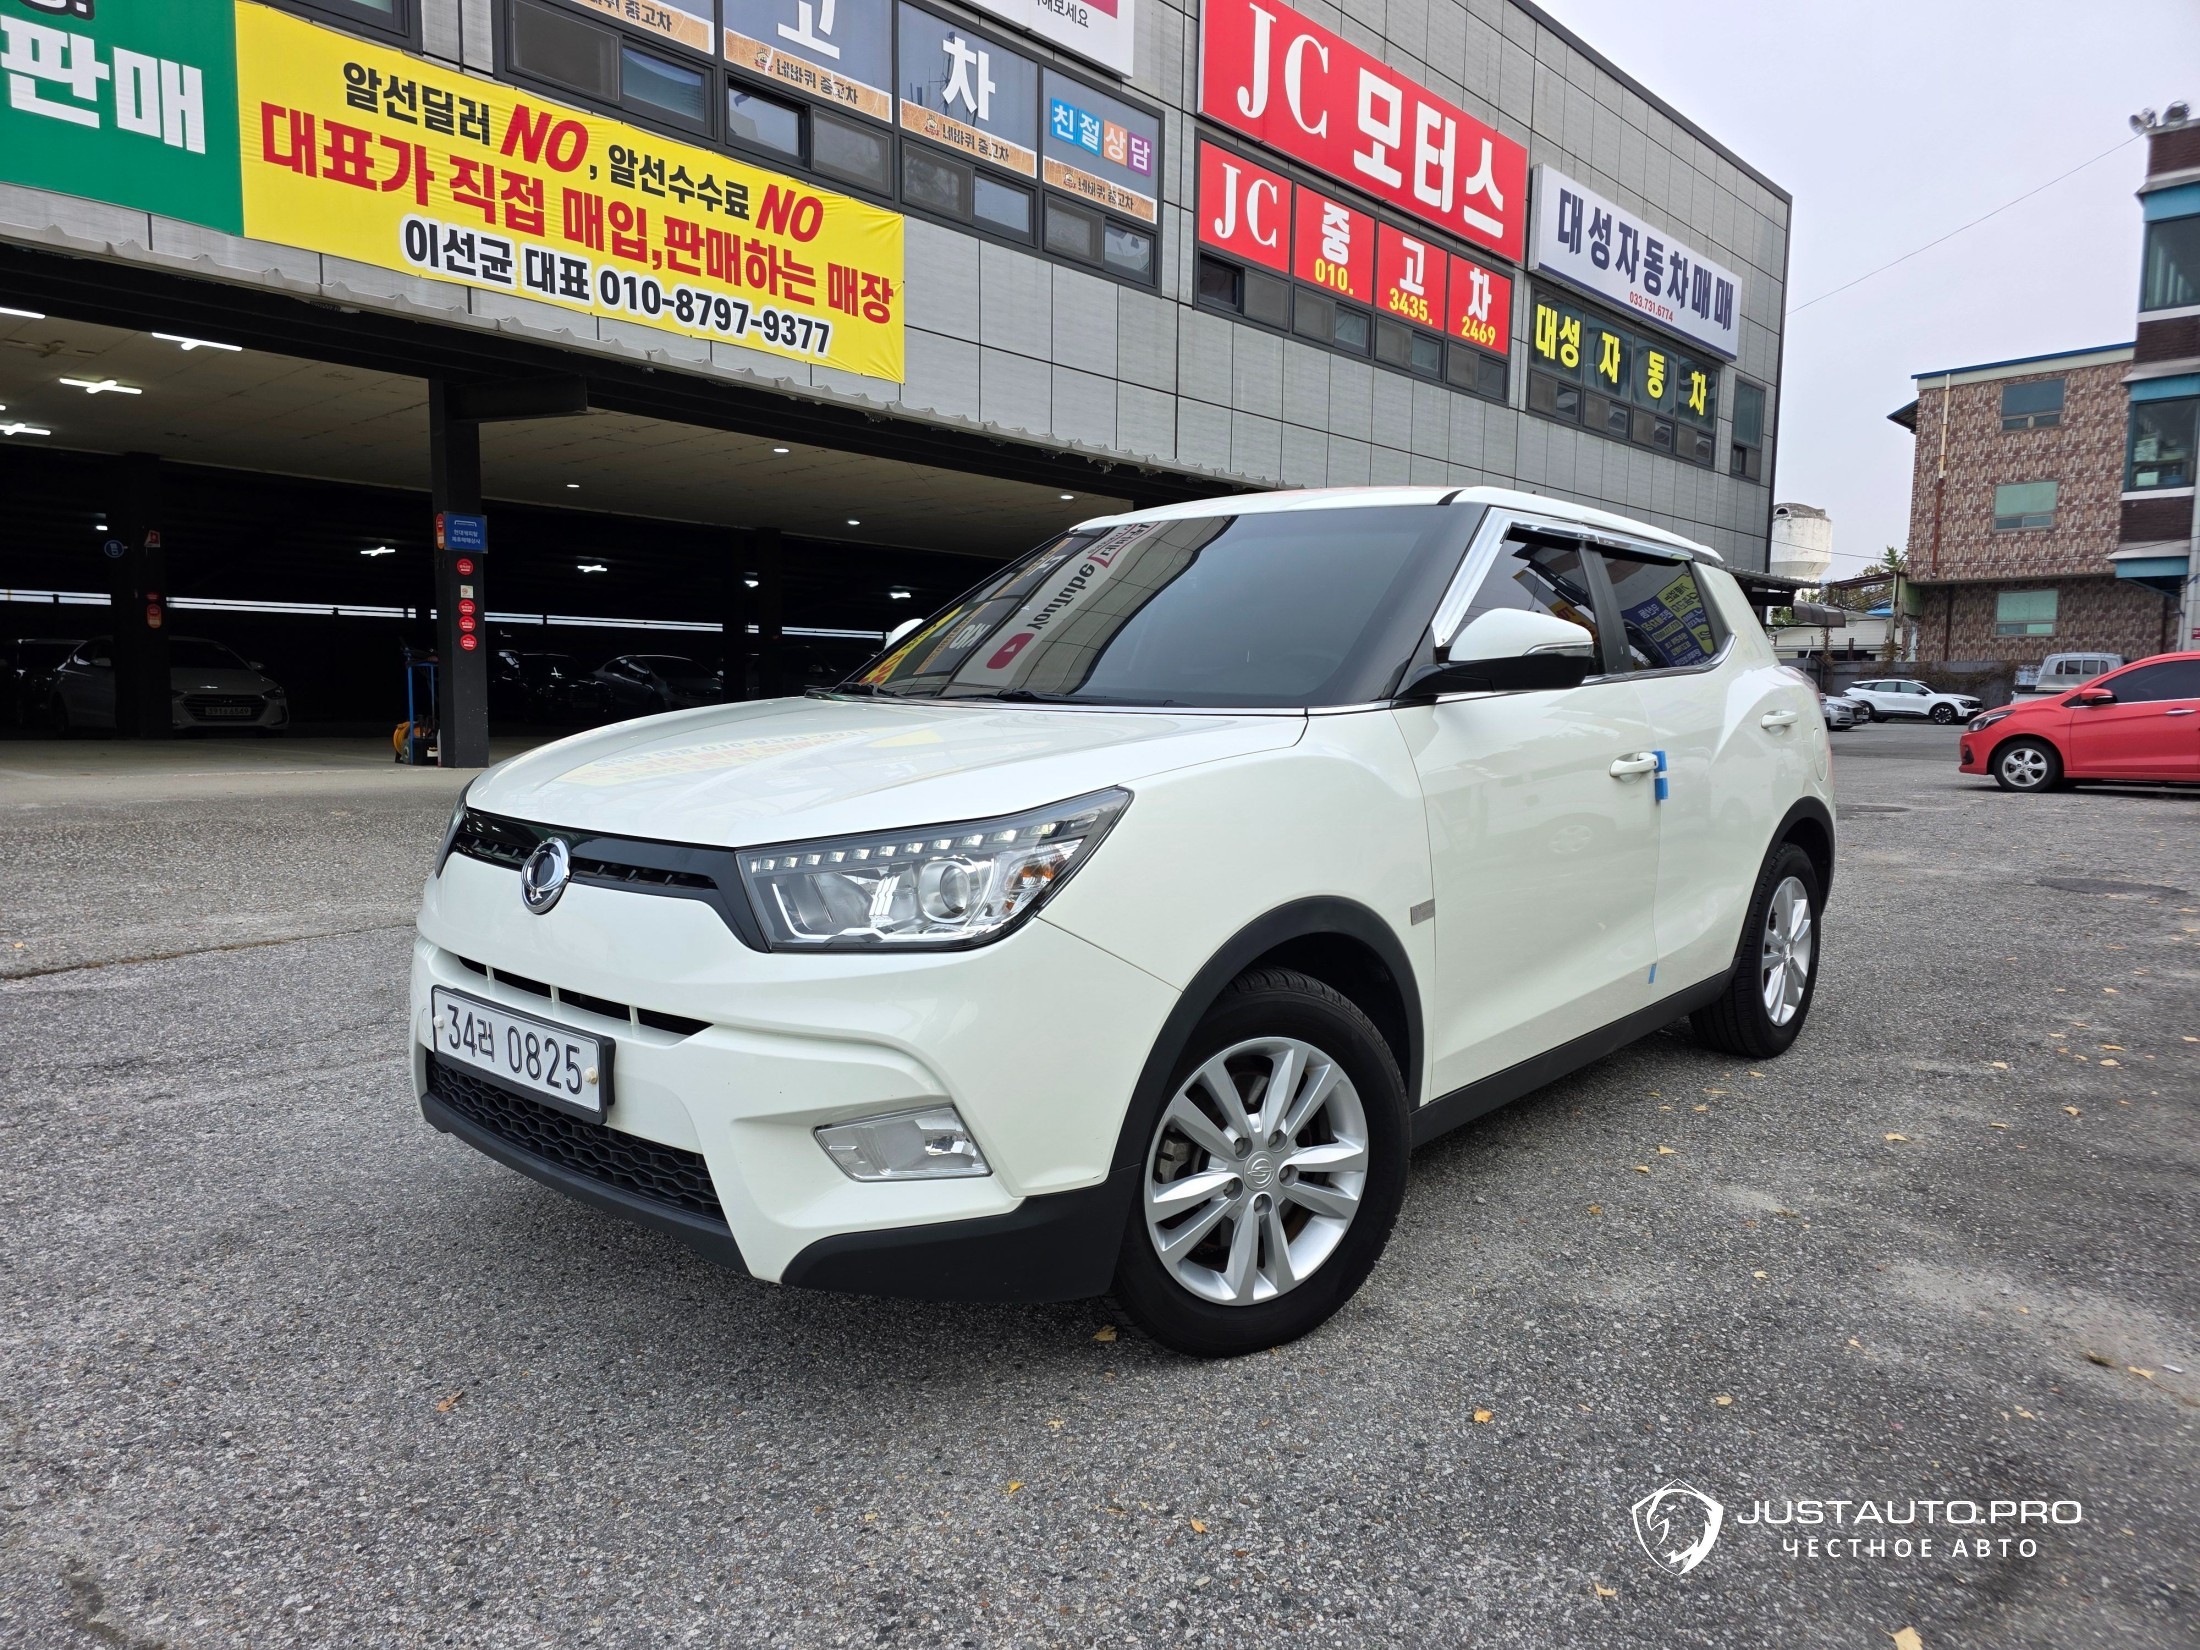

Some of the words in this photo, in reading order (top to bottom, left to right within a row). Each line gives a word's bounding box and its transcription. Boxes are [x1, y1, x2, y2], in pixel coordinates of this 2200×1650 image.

[1036, 0, 1089, 28] 해보세요
[0, 14, 206, 155] 판매
[941, 36, 996, 122] 차
[1236, 3, 1329, 139] JC
[1353, 66, 1505, 240] 모터스
[343, 61, 491, 146] 알선딜러
[607, 143, 750, 222] 알선수수료
[755, 184, 825, 243] NO
[1053, 104, 1100, 152] 친절
[1105, 128, 1151, 171] 상담
[260, 101, 435, 207] 대표가
[449, 154, 546, 238] 직접
[827, 262, 894, 325] 매장
[1214, 162, 1279, 249] JC
[404, 218, 514, 285] 이선균
[525, 247, 591, 302] 대표
[600, 269, 831, 354] 010-8797-9377
[1557, 187, 1735, 331] 대성자동차매매
[1460, 314, 1497, 347] 2469
[1628, 290, 1675, 323] 033.731.6774
[447, 1003, 495, 1063] 34러
[507, 1025, 583, 1095] 0825
